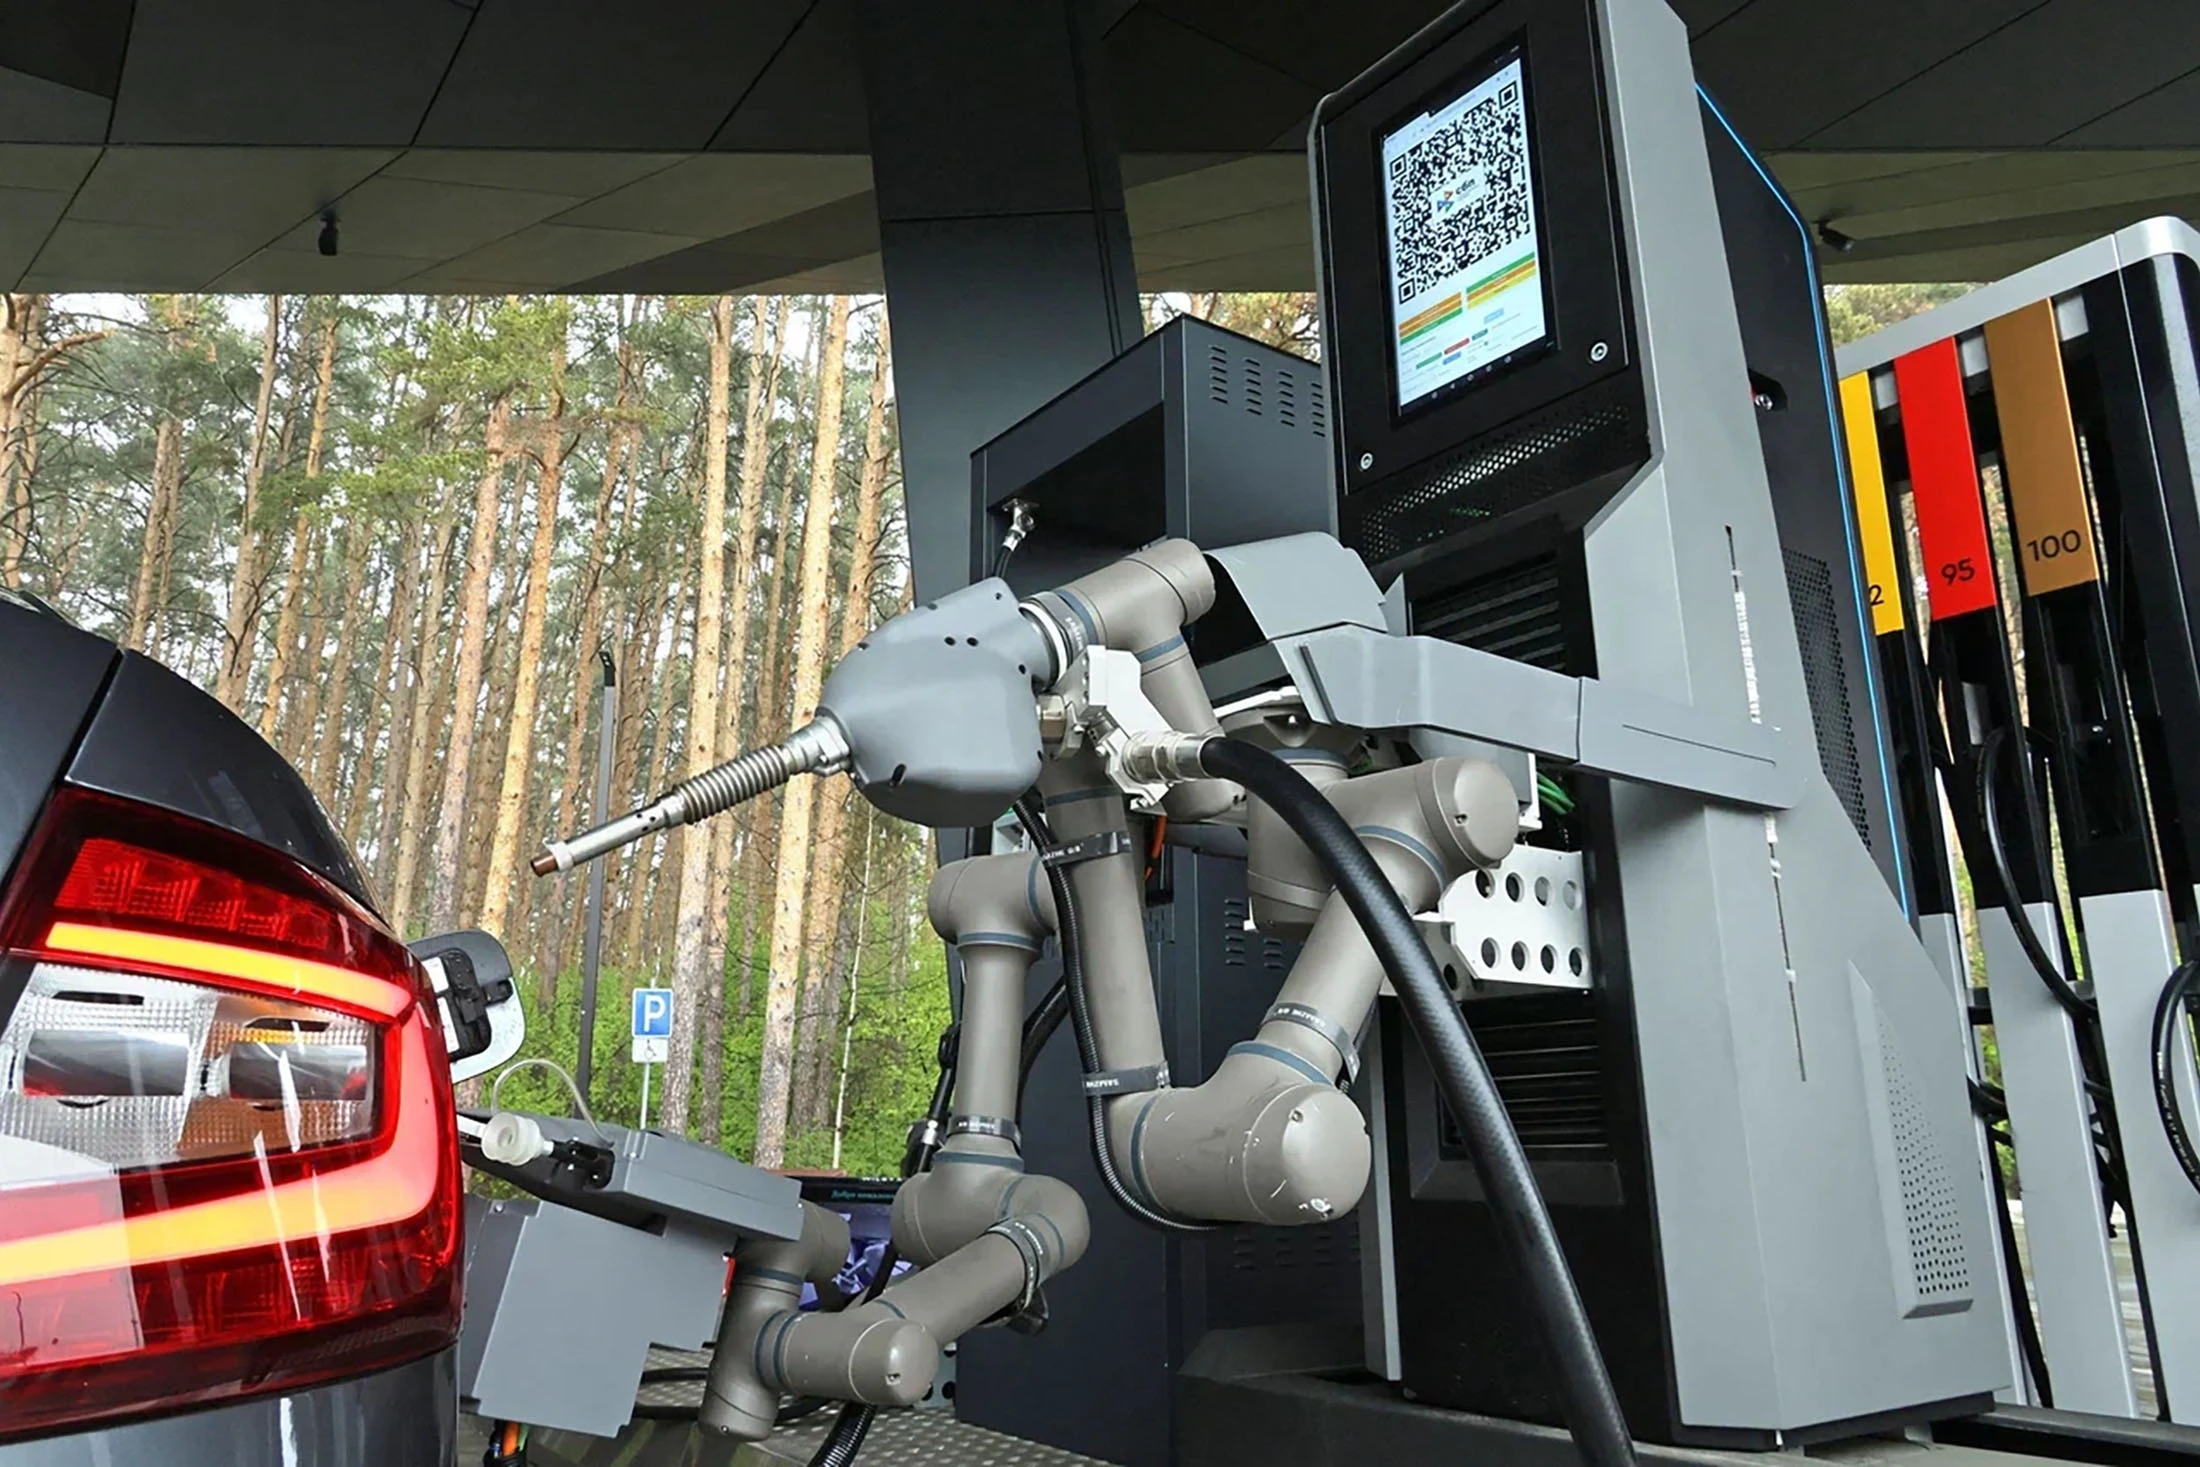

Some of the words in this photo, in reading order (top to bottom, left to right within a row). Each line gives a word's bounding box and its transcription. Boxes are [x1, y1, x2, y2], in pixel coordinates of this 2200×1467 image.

[2026, 529, 2081, 562] 100
[1940, 557, 1975, 586] 95
[1868, 584, 1885, 606] 2
[643, 994, 667, 1032] P
